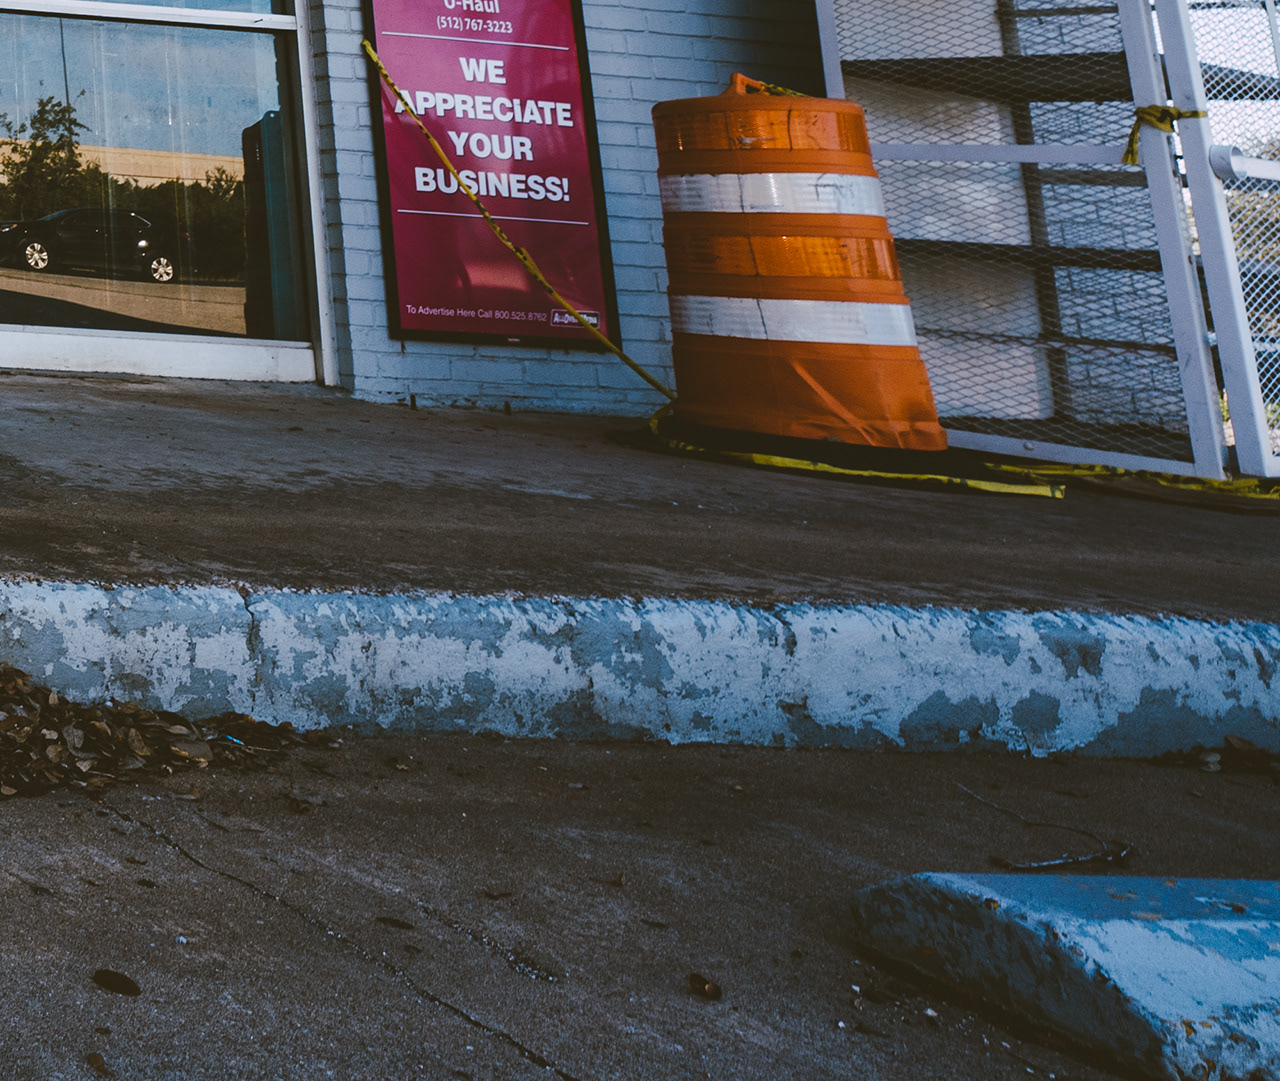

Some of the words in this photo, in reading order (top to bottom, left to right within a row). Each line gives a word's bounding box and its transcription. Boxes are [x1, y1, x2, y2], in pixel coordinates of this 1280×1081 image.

[436, 15, 463, 31] (512)
[465, 18, 513, 34] 767-3223
[459, 57, 507, 84] WE
[394, 89, 575, 128] APPRECIATE
[448, 130, 534, 162] YOUR
[414, 166, 571, 202] BUSINESS!
[406, 304, 417, 314] To
[418, 305, 455, 317] Advertise
[456, 308, 476, 318] Here
[477, 308, 493, 319] Call
[494, 309, 548, 322] 800.525.8762
